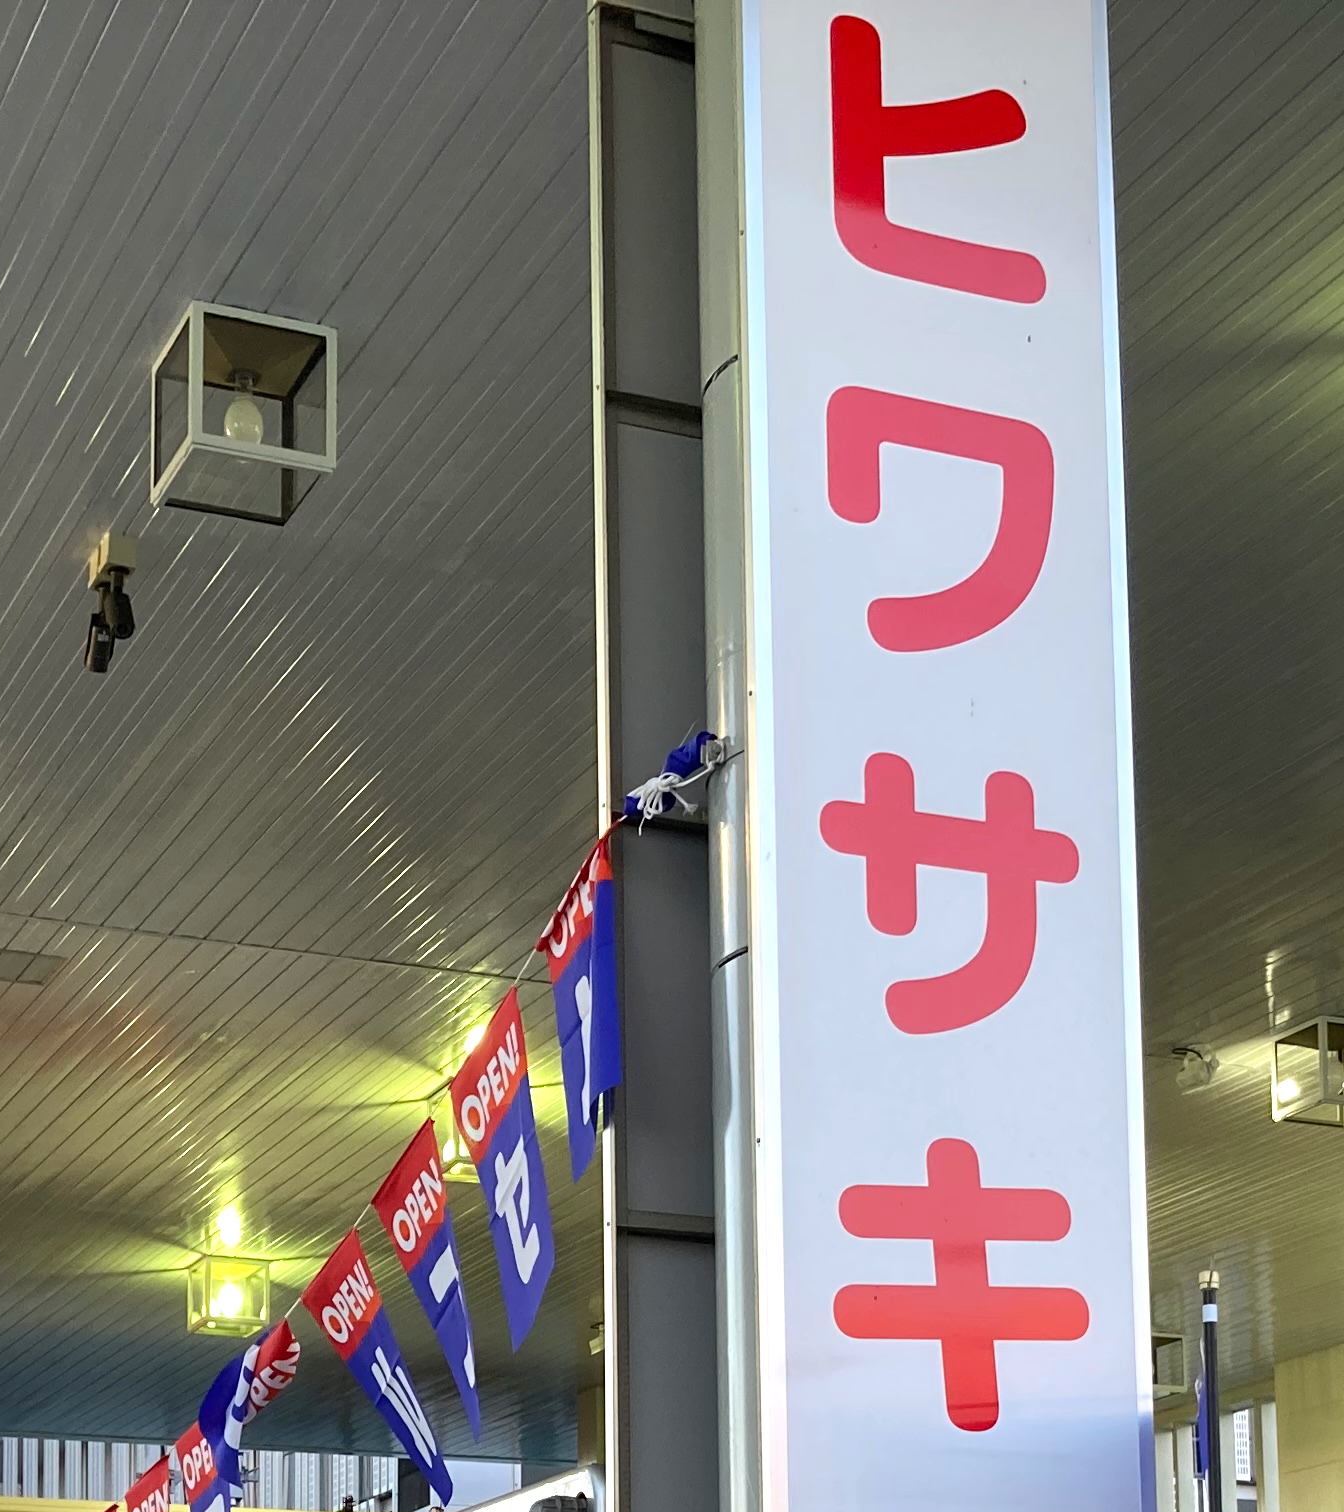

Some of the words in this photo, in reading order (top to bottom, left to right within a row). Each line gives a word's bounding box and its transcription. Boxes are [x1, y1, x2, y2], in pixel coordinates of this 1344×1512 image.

[820, 15, 1089, 1431] ヒワサキ
[461, 1022, 520, 1142] OPEN!
[495, 1134, 540, 1284] セ
[322, 1259, 374, 1344] OPEN!
